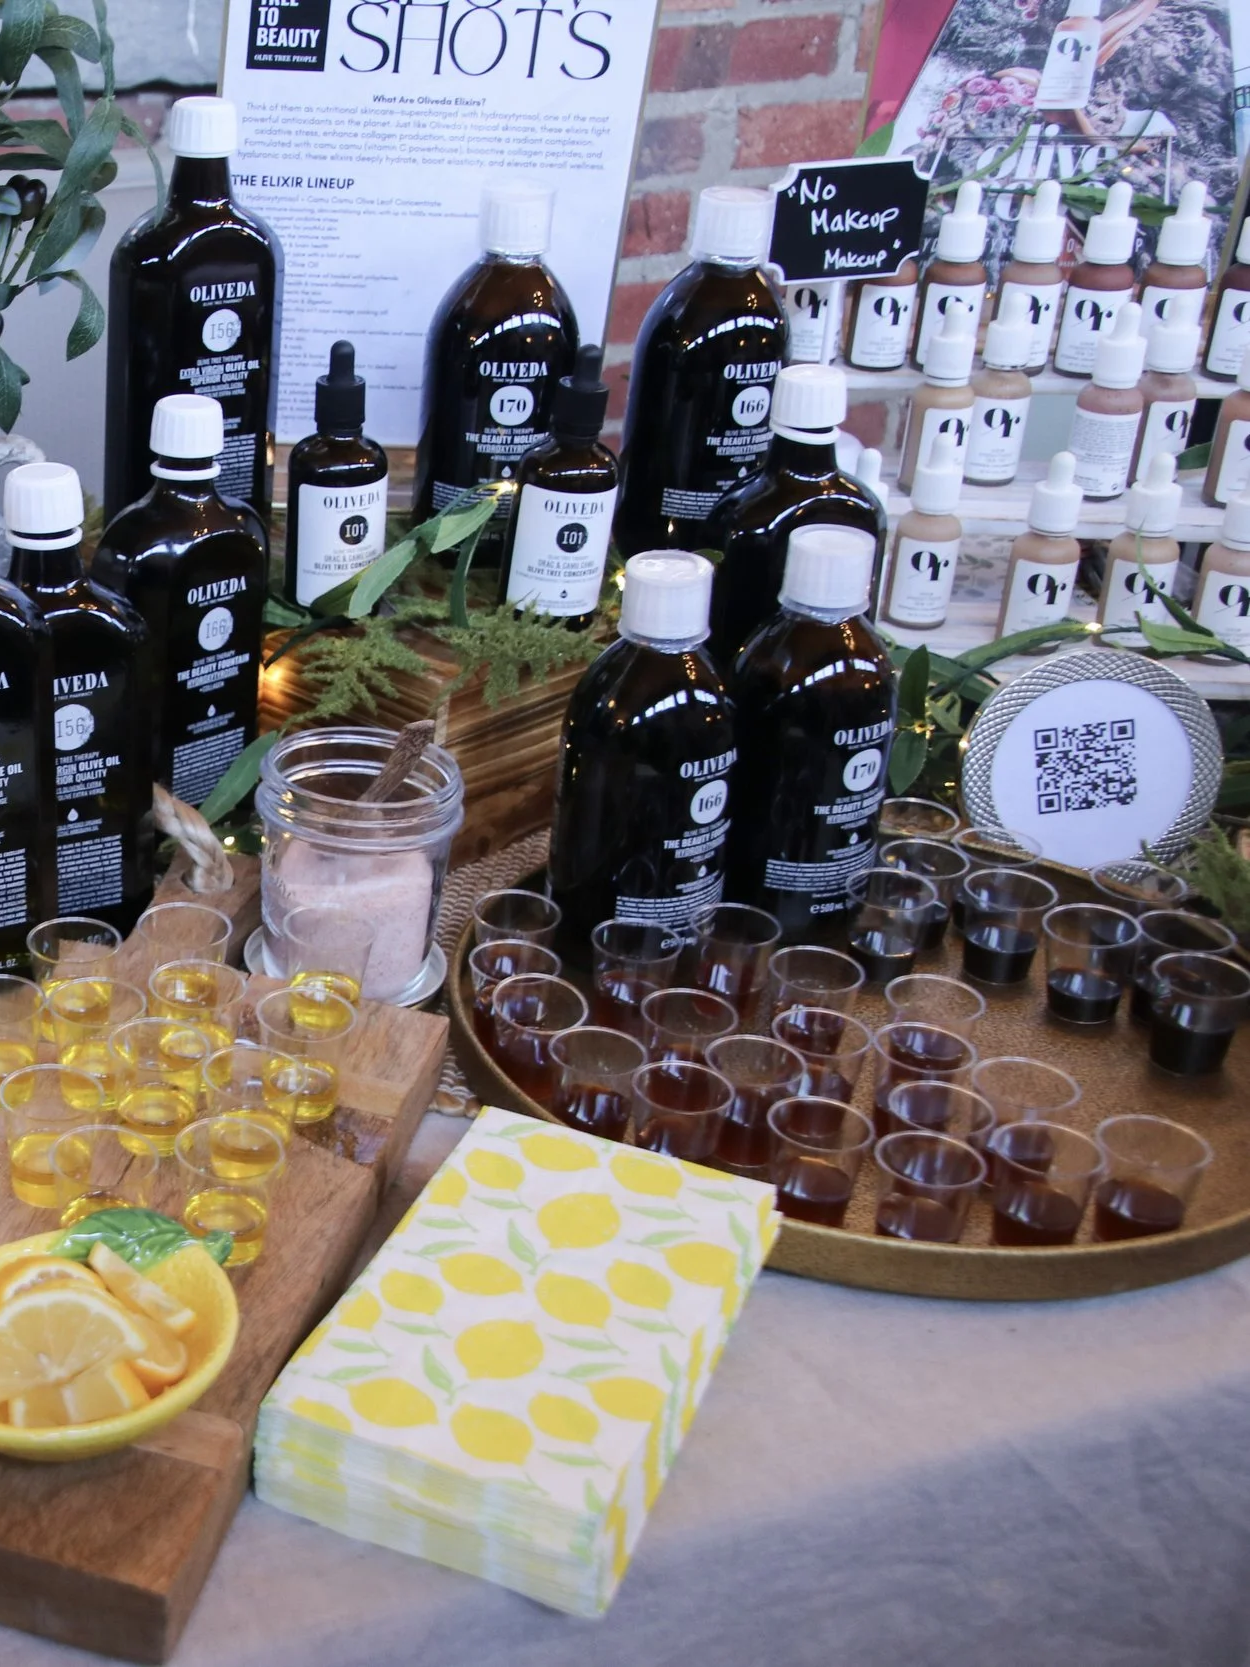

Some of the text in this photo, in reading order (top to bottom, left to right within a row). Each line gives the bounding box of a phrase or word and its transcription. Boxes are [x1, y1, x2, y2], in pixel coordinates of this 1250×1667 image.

[258, 7, 279, 28] TO
[256, 28, 320, 49] BEAUTY
[339, 3, 613, 80] SHOTS
[274, 54, 292, 63] TREE
[293, 55, 318, 64] PEOPLE
[246, 102, 358, 115] Think them nutritional
[372, 95, 486, 107] What Are Oliveda Elixirs?
[242, 115, 279, 125] powerful
[347, 117, 360, 126] the
[413, 119, 426, 128] like
[591, 126, 611, 137] fight
[231, 174, 355, 190] THE ELIXIR LINEUP
[811, 207, 900, 236] Makeup
[190, 280, 255, 303] OLIVEDA
[225, 361, 246, 372] OLIVE
[247, 359, 260, 370] OIL
[479, 361, 548, 377] OLIVEDA
[222, 371, 249, 383] QUALITY
[465, 432, 512, 445] THE BEAUTY
[706, 436, 751, 446] THE BEAUTY
[323, 490, 380, 509] OLIVEDA
[544, 499, 604, 516] OLIVEDA
[187, 575, 247, 605] OLIVEDA
[177, 669, 190, 682] THE
[191, 662, 217, 678] BEAUTY
[53, 671, 109, 696] IVEDA
[7, 763, 23, 775] OIL
[78, 755, 121, 772] OLIVE OIL
[75, 768, 107, 782] QUALITY
[813, 801, 862, 815] THE BEAUTY
[663, 833, 709, 849] THE BEAUTY
